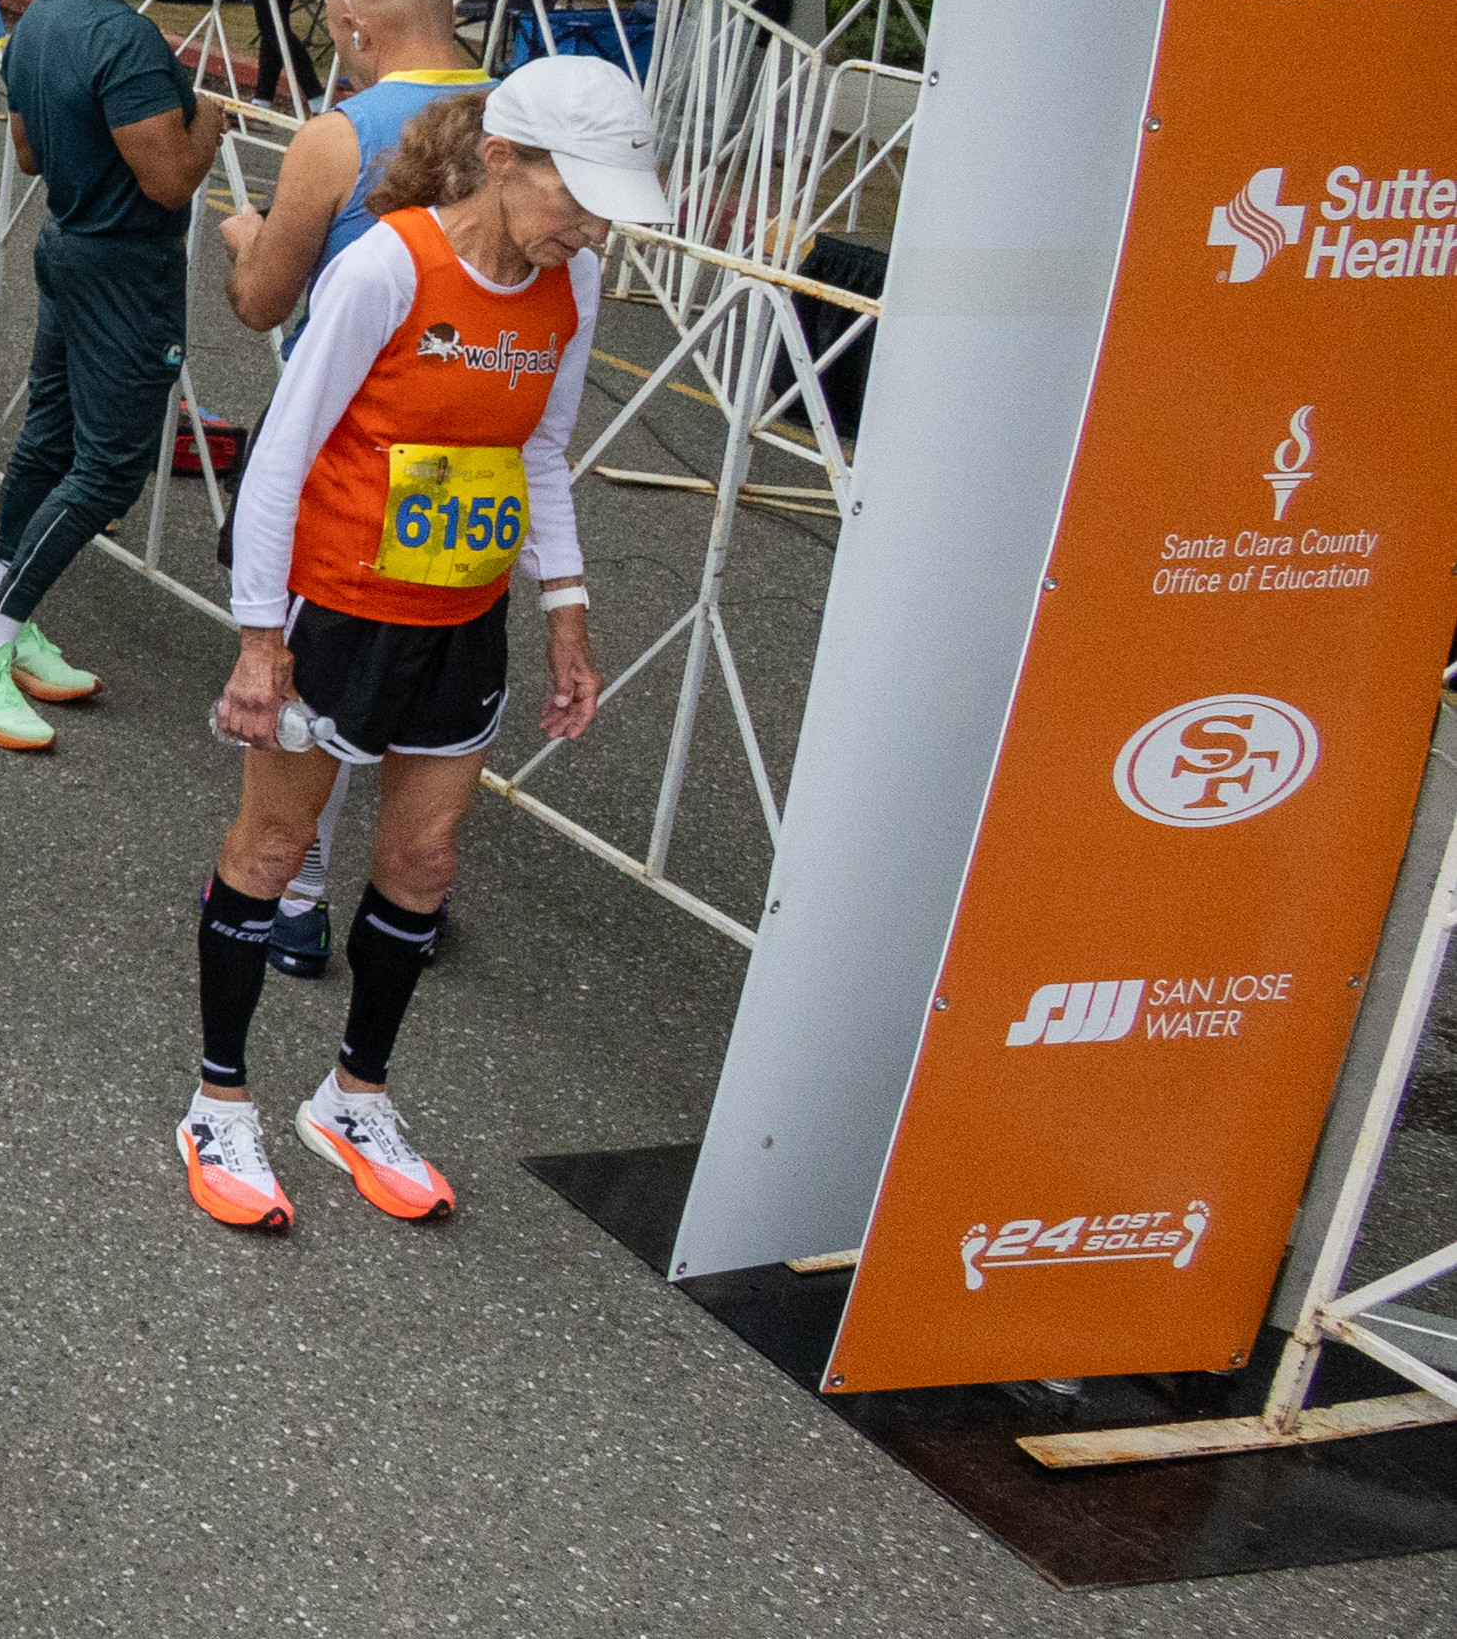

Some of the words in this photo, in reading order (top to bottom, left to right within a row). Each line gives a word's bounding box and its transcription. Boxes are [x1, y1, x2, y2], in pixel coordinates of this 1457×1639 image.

[396, 494, 522, 551] 6156
[1161, 533, 1227, 561] Santa
[1233, 529, 1294, 558] Clara
[1300, 528, 1379, 559] County
[1152, 568, 1221, 595] Office
[1228, 566, 1257, 593] of
[1260, 564, 1371, 591] Education
[1147, 976, 1216, 1007] SAN
[1220, 973, 1293, 1004] JOSE
[1144, 1009, 1243, 1041] WATER
[985, 1216, 1088, 1258] 24
[1090, 1211, 1173, 1232] LOST
[1082, 1229, 1187, 1251] SOLES
